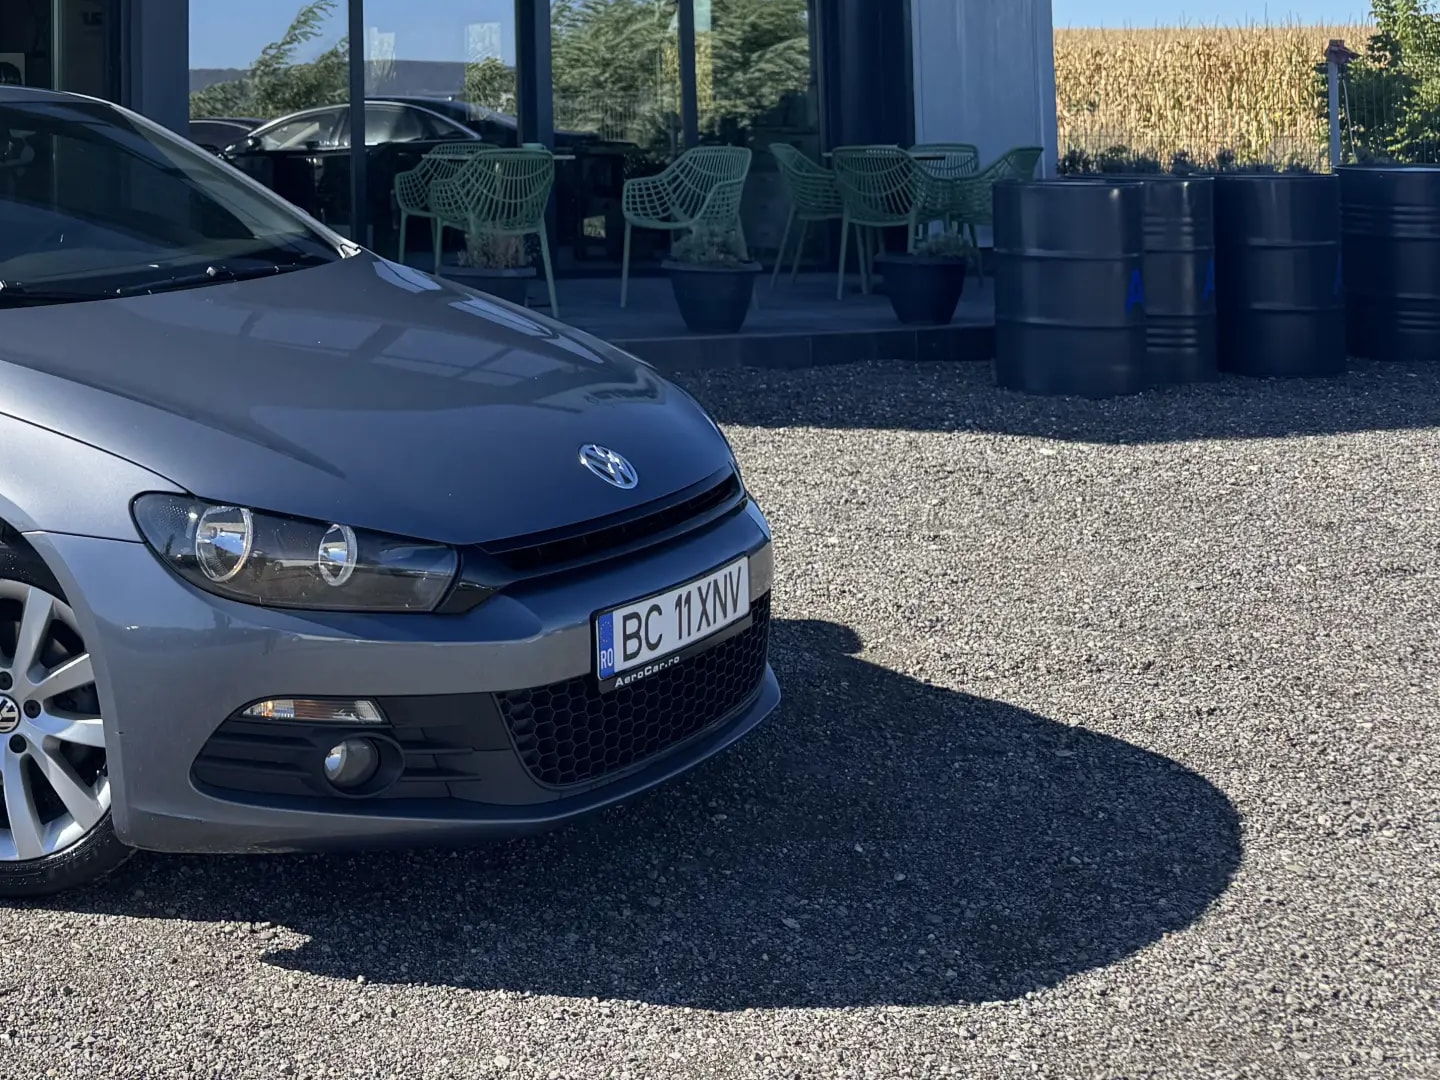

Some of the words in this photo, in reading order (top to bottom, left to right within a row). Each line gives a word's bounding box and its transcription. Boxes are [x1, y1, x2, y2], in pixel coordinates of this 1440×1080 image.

[622, 603, 663, 663] BC
[600, 647, 614, 670] RO
[614, 655, 680, 688] AeroCar.ro
